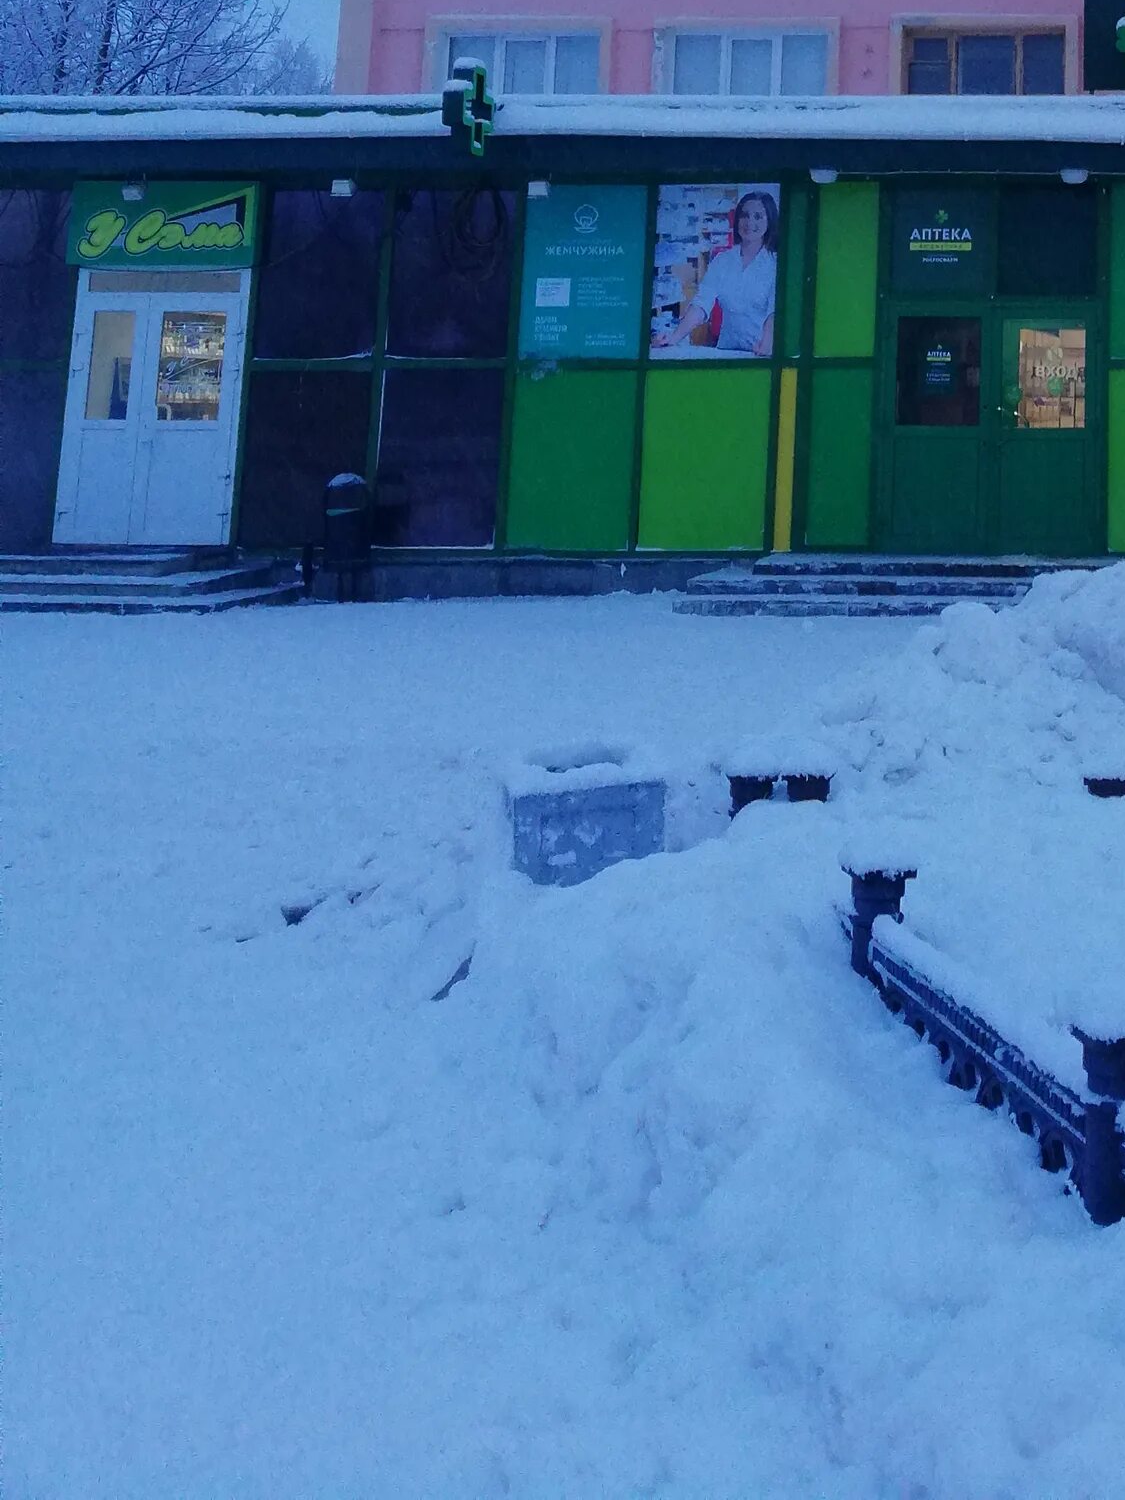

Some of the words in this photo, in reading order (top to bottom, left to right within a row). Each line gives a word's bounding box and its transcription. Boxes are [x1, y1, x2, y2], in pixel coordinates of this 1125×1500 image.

[77, 209, 127, 259] У
[910, 228, 972, 241] АПТЕКА
[545, 246, 625, 256] ЖЕМЧУЖИНА
